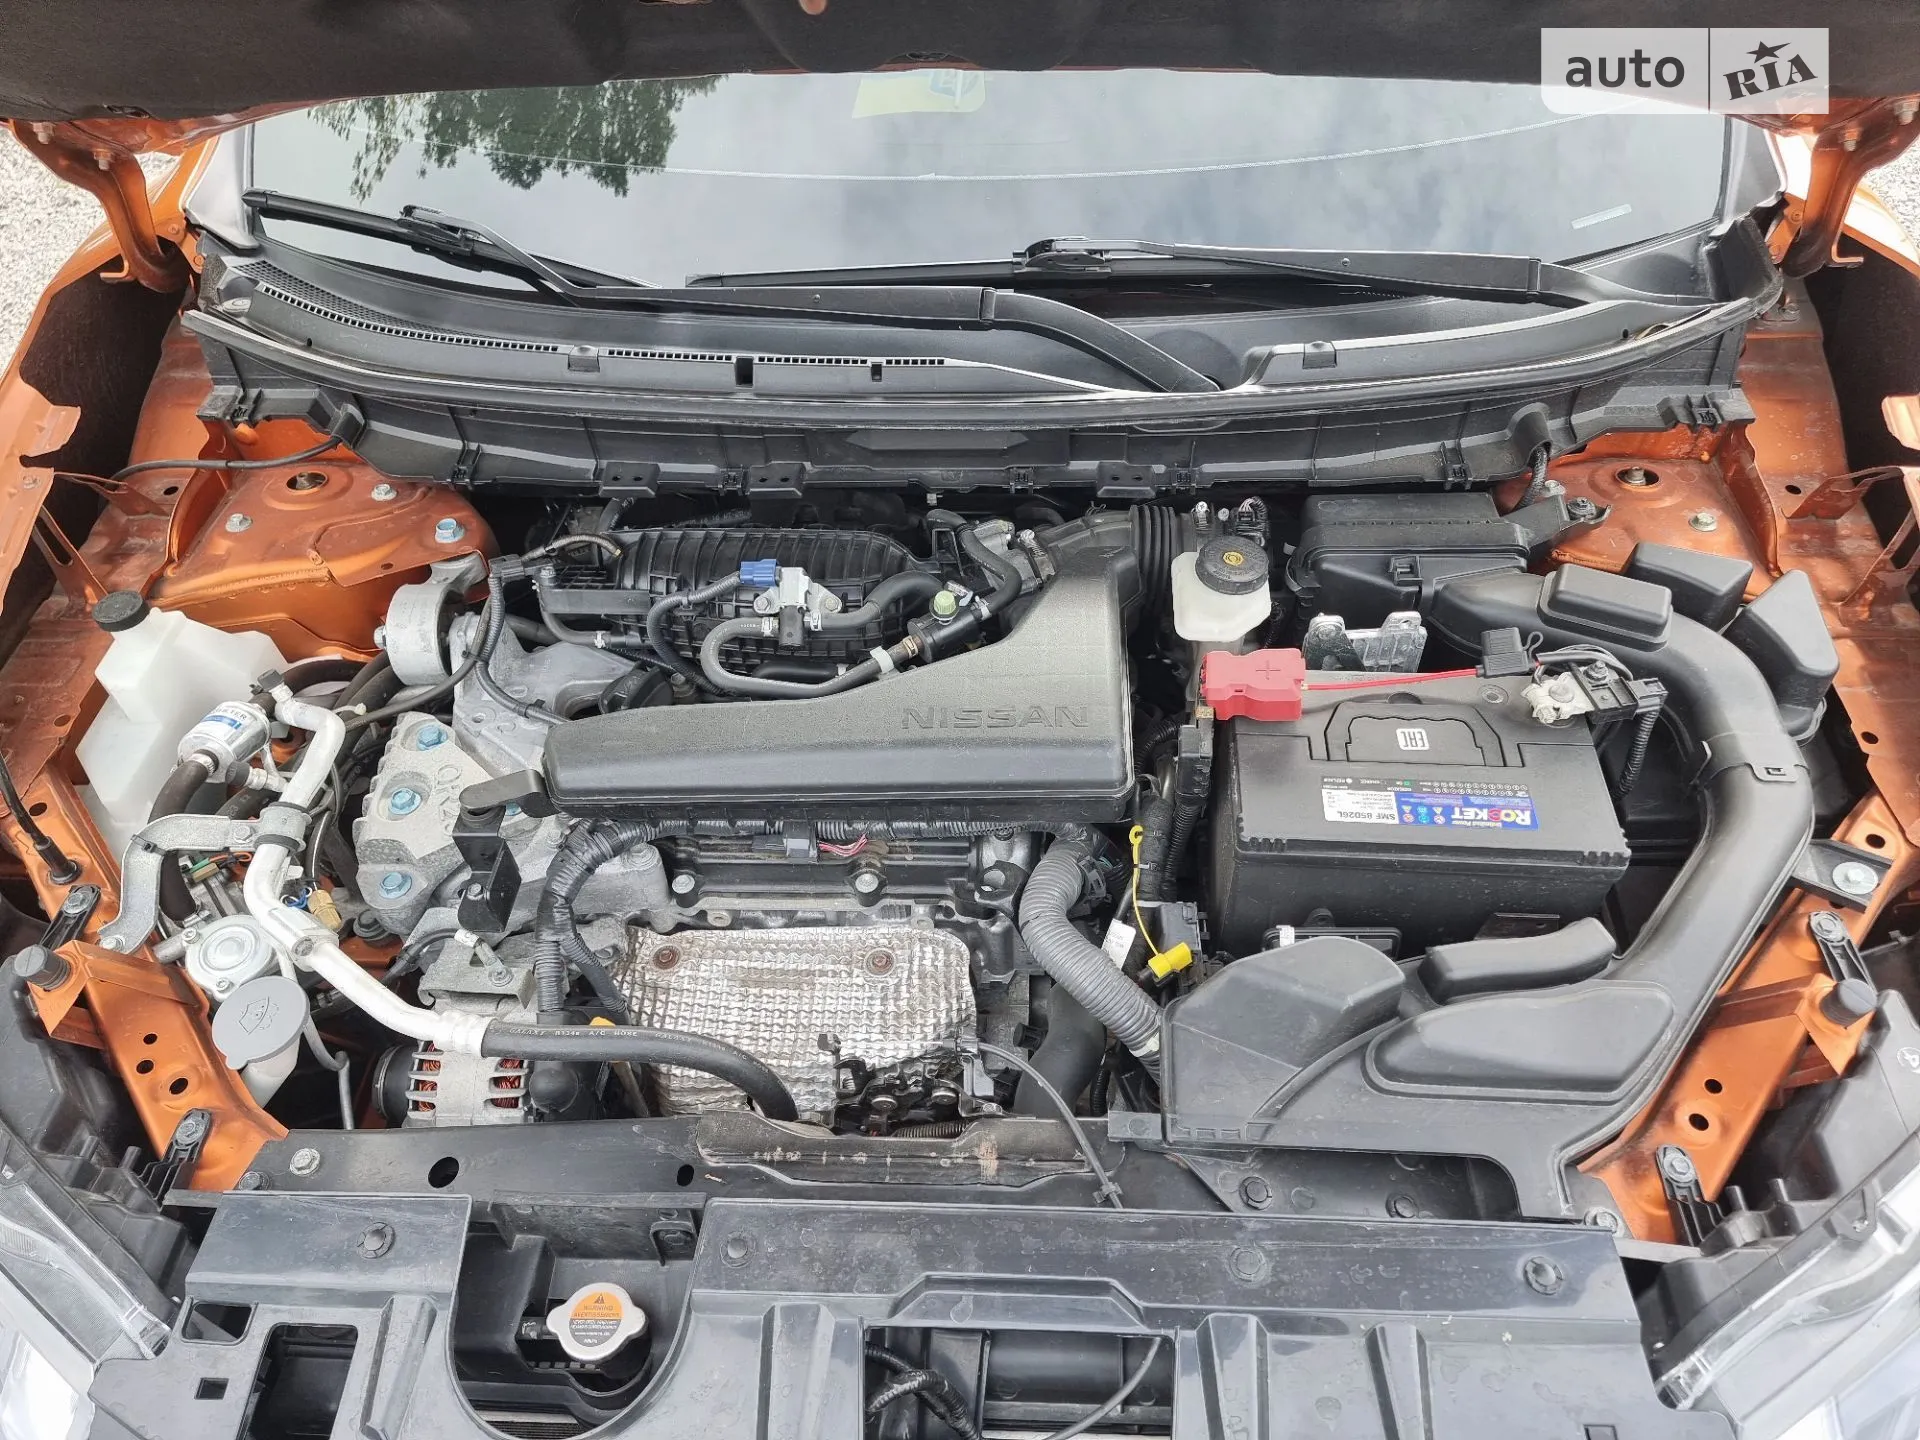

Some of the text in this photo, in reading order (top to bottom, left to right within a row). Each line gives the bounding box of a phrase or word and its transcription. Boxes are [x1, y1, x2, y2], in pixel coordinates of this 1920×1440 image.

[900, 705, 1089, 730] NISSAN
[1375, 812, 1396, 821] SMF
[1451, 806, 1531, 826] ROCKET
